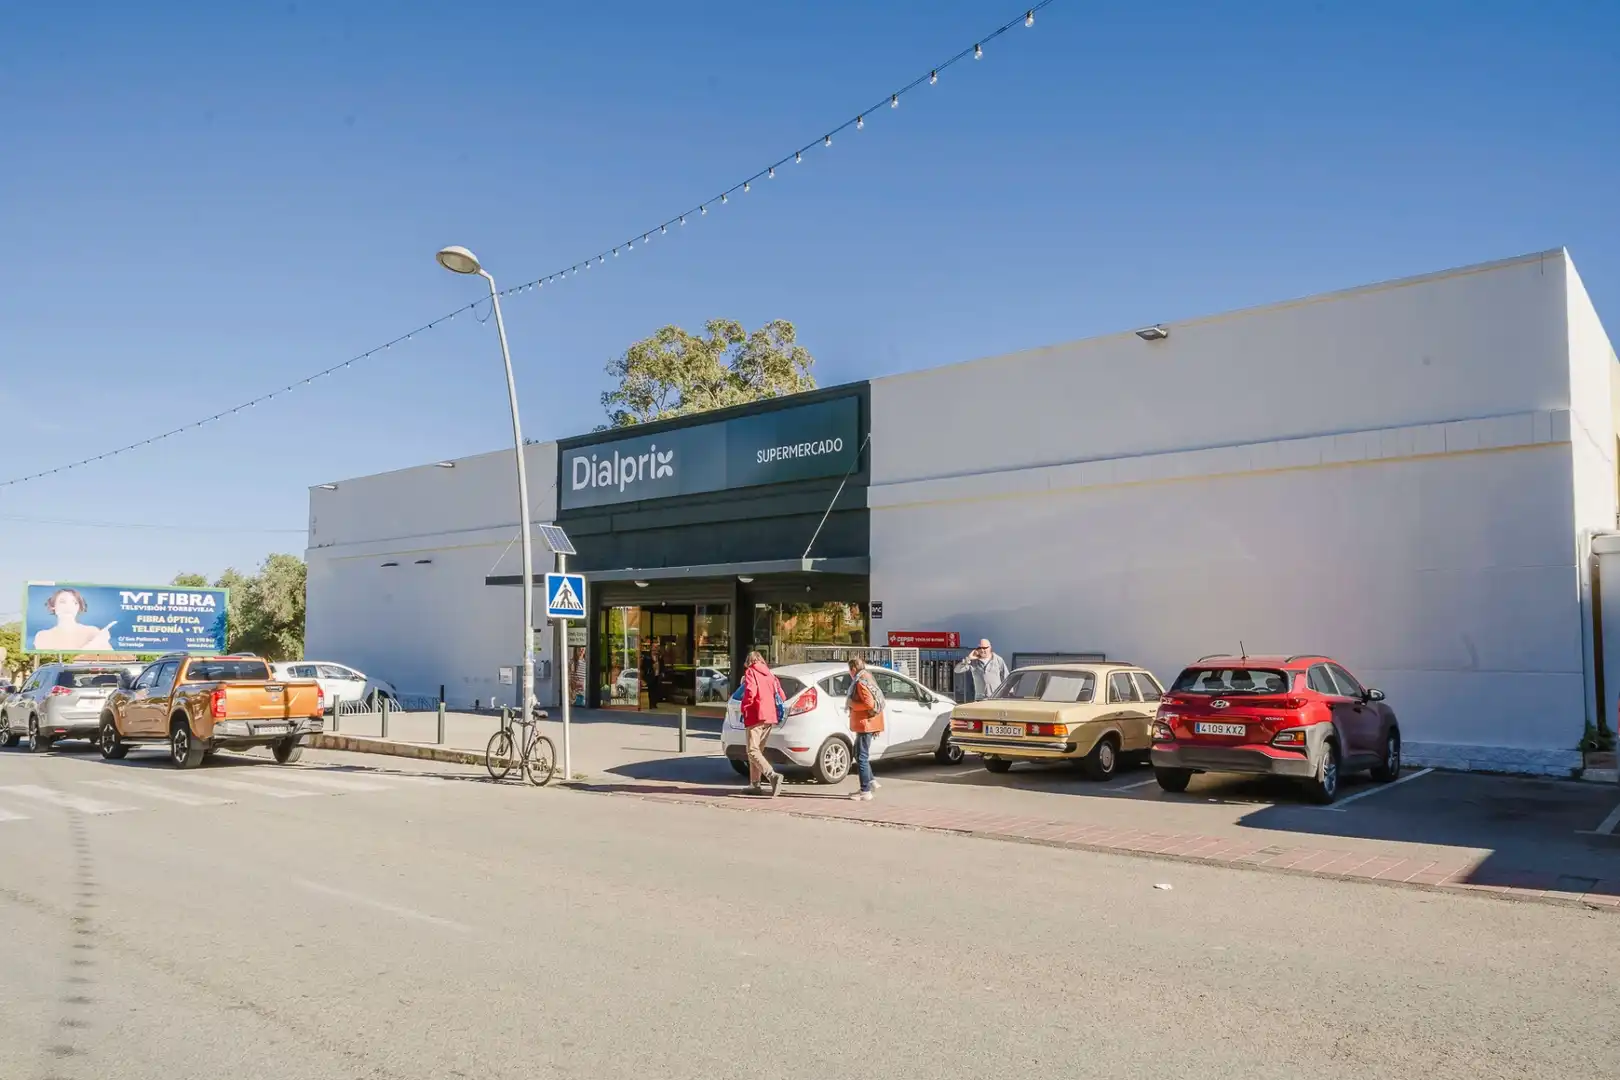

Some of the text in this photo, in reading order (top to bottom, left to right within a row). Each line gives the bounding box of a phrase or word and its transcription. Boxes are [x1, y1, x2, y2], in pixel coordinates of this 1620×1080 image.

[756, 437, 843, 464] SUPERMERCADO
[572, 444, 674, 492] Dialprix
[158, 592, 216, 606] FIBRA
[136, 613, 200, 624] FIBRA ÓPTICA
[132, 624, 204, 634] TELEFONÍA TV
[995, 726, 1012, 735] 3300
[1201, 723, 1244, 735] 4109 KXZ
